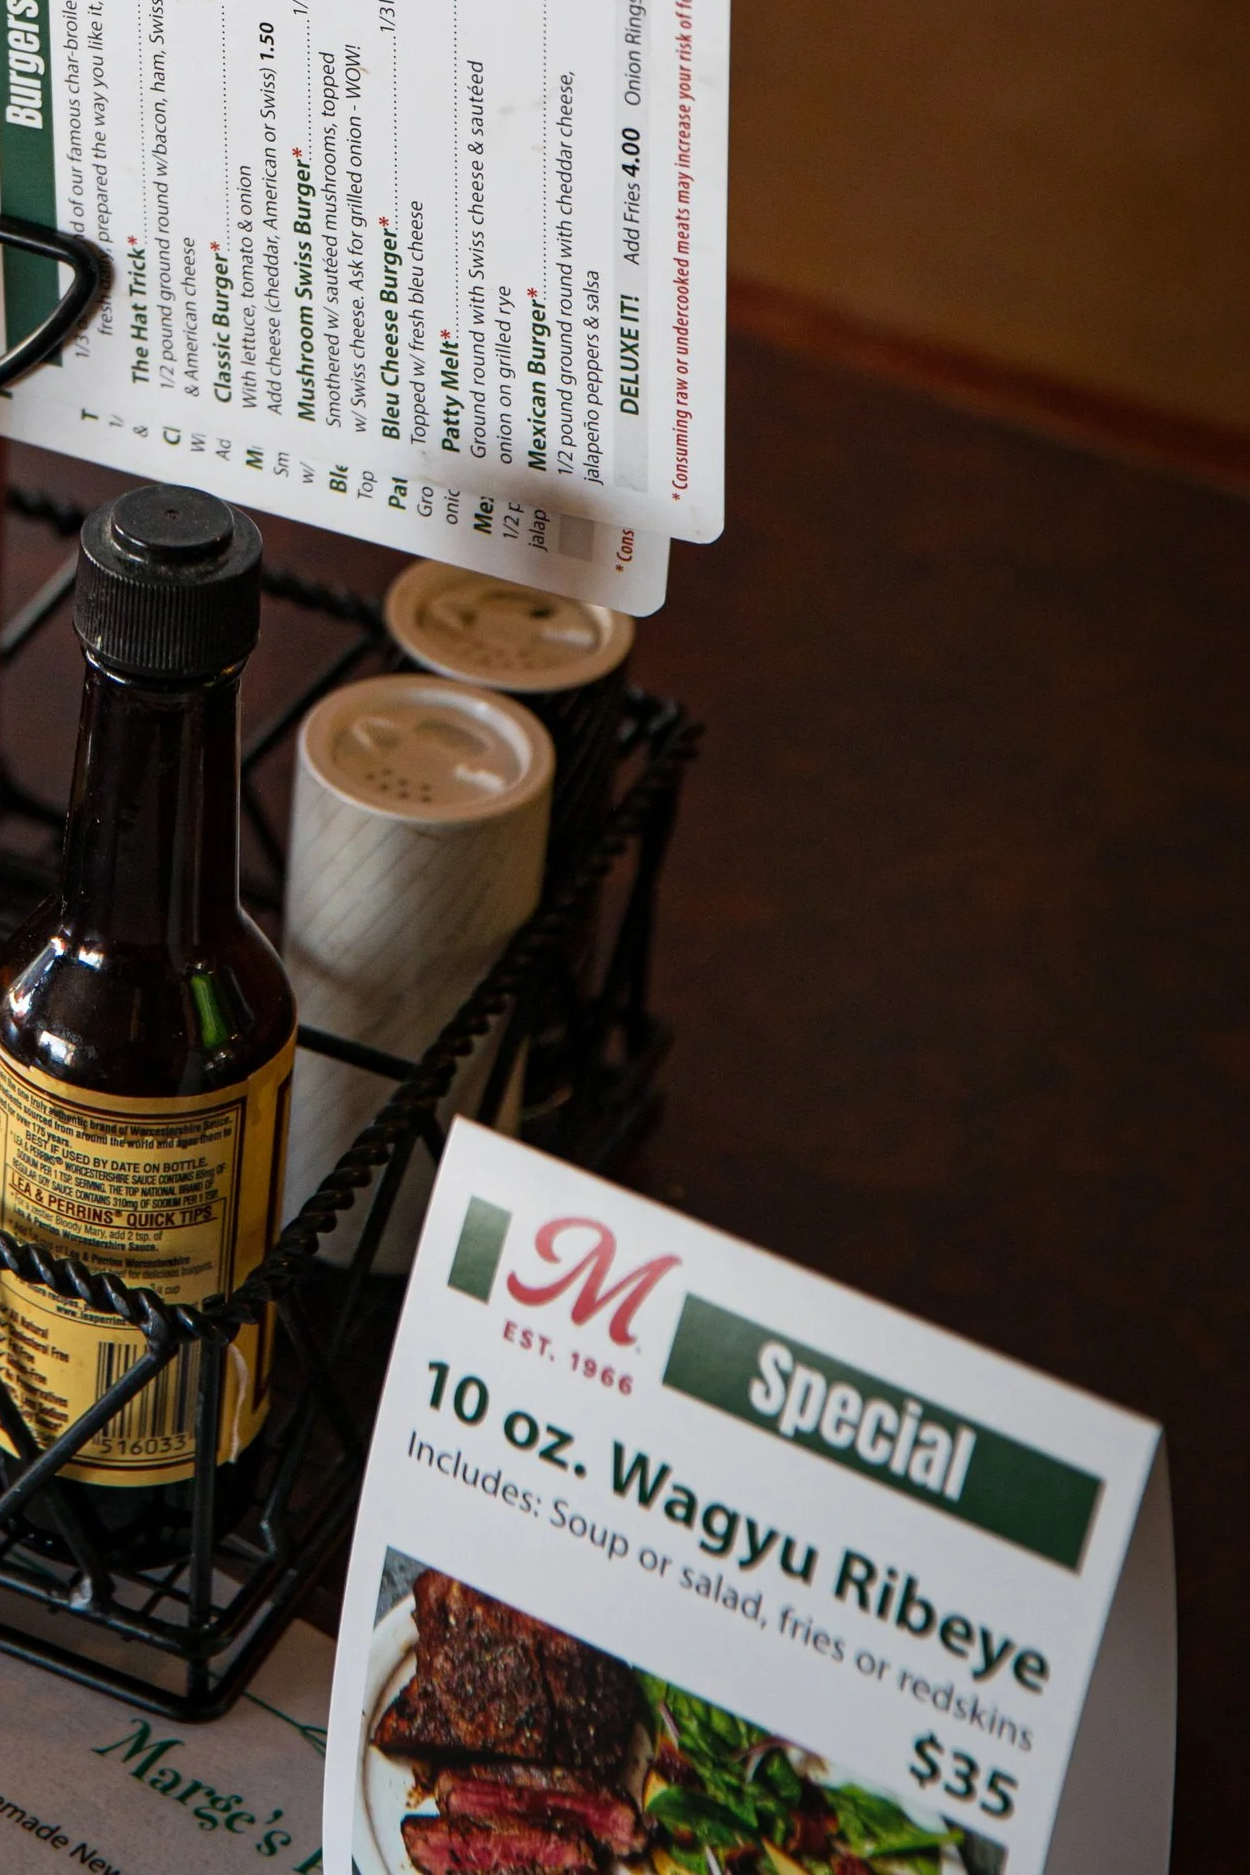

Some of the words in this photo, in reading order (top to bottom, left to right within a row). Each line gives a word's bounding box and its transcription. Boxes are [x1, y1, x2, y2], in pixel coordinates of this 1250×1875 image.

[674, 10, 693, 30] of
[674, 32, 693, 63] risk
[623, 49, 642, 107] Onion
[678, 64, 696, 102] your
[620, 126, 642, 179] 4.00
[673, 103, 692, 169] increase
[236, 165, 253, 216] onion
[622, 181, 641, 225] Fries
[677, 170, 695, 205] may
[236, 219, 254, 233] &
[621, 226, 641, 267] Add
[674, 207, 691, 256] meats
[239, 236, 255, 299] tomato
[619, 293, 640, 324] IT!
[671, 256, 690, 356] undercooked
[239, 304, 257, 367] lettuce,
[240, 370, 258, 409] With
[617, 325, 641, 417] DELUXE
[675, 376, 689, 407] raw
[676, 357, 690, 376] or
[671, 408, 691, 491] Consuming
[25, 1130, 50, 1150] BEST
[50, 1143, 60, 1156] IF
[62, 1148, 91, 1166] USED
[93, 1157, 108, 1169] BY
[111, 1162, 140, 1173] DATE
[143, 1162, 160, 1173] ON
[163, 1156, 209, 1173] BOTTLE.
[11, 1173, 32, 1197] LEA
[34, 1188, 44, 1203] &
[127, 1213, 175, 1227] QUICK
[180, 1205, 213, 1221] TIPS
[505, 1216, 682, 1348] M
[502, 1319, 554, 1361] EST.
[570, 1352, 632, 1396] 1966
[750, 1340, 974, 1498] Special
[427, 1358, 490, 1428] 10
[501, 1408, 588, 1481] oz.
[610, 1438, 820, 1587] Wagyu
[831, 1545, 1051, 1696] Ribeye
[407, 1428, 542, 1518] Includes:
[549, 1497, 630, 1561] Soup
[637, 1546, 673, 1578] or
[679, 1564, 768, 1630] salad,
[777, 1604, 845, 1663] fries
[853, 1649, 891, 1681] or
[897, 1667, 1032, 1752] redskins
[91, 1717, 293, 1859] Marge's
[907, 1729, 1019, 1822] $35
